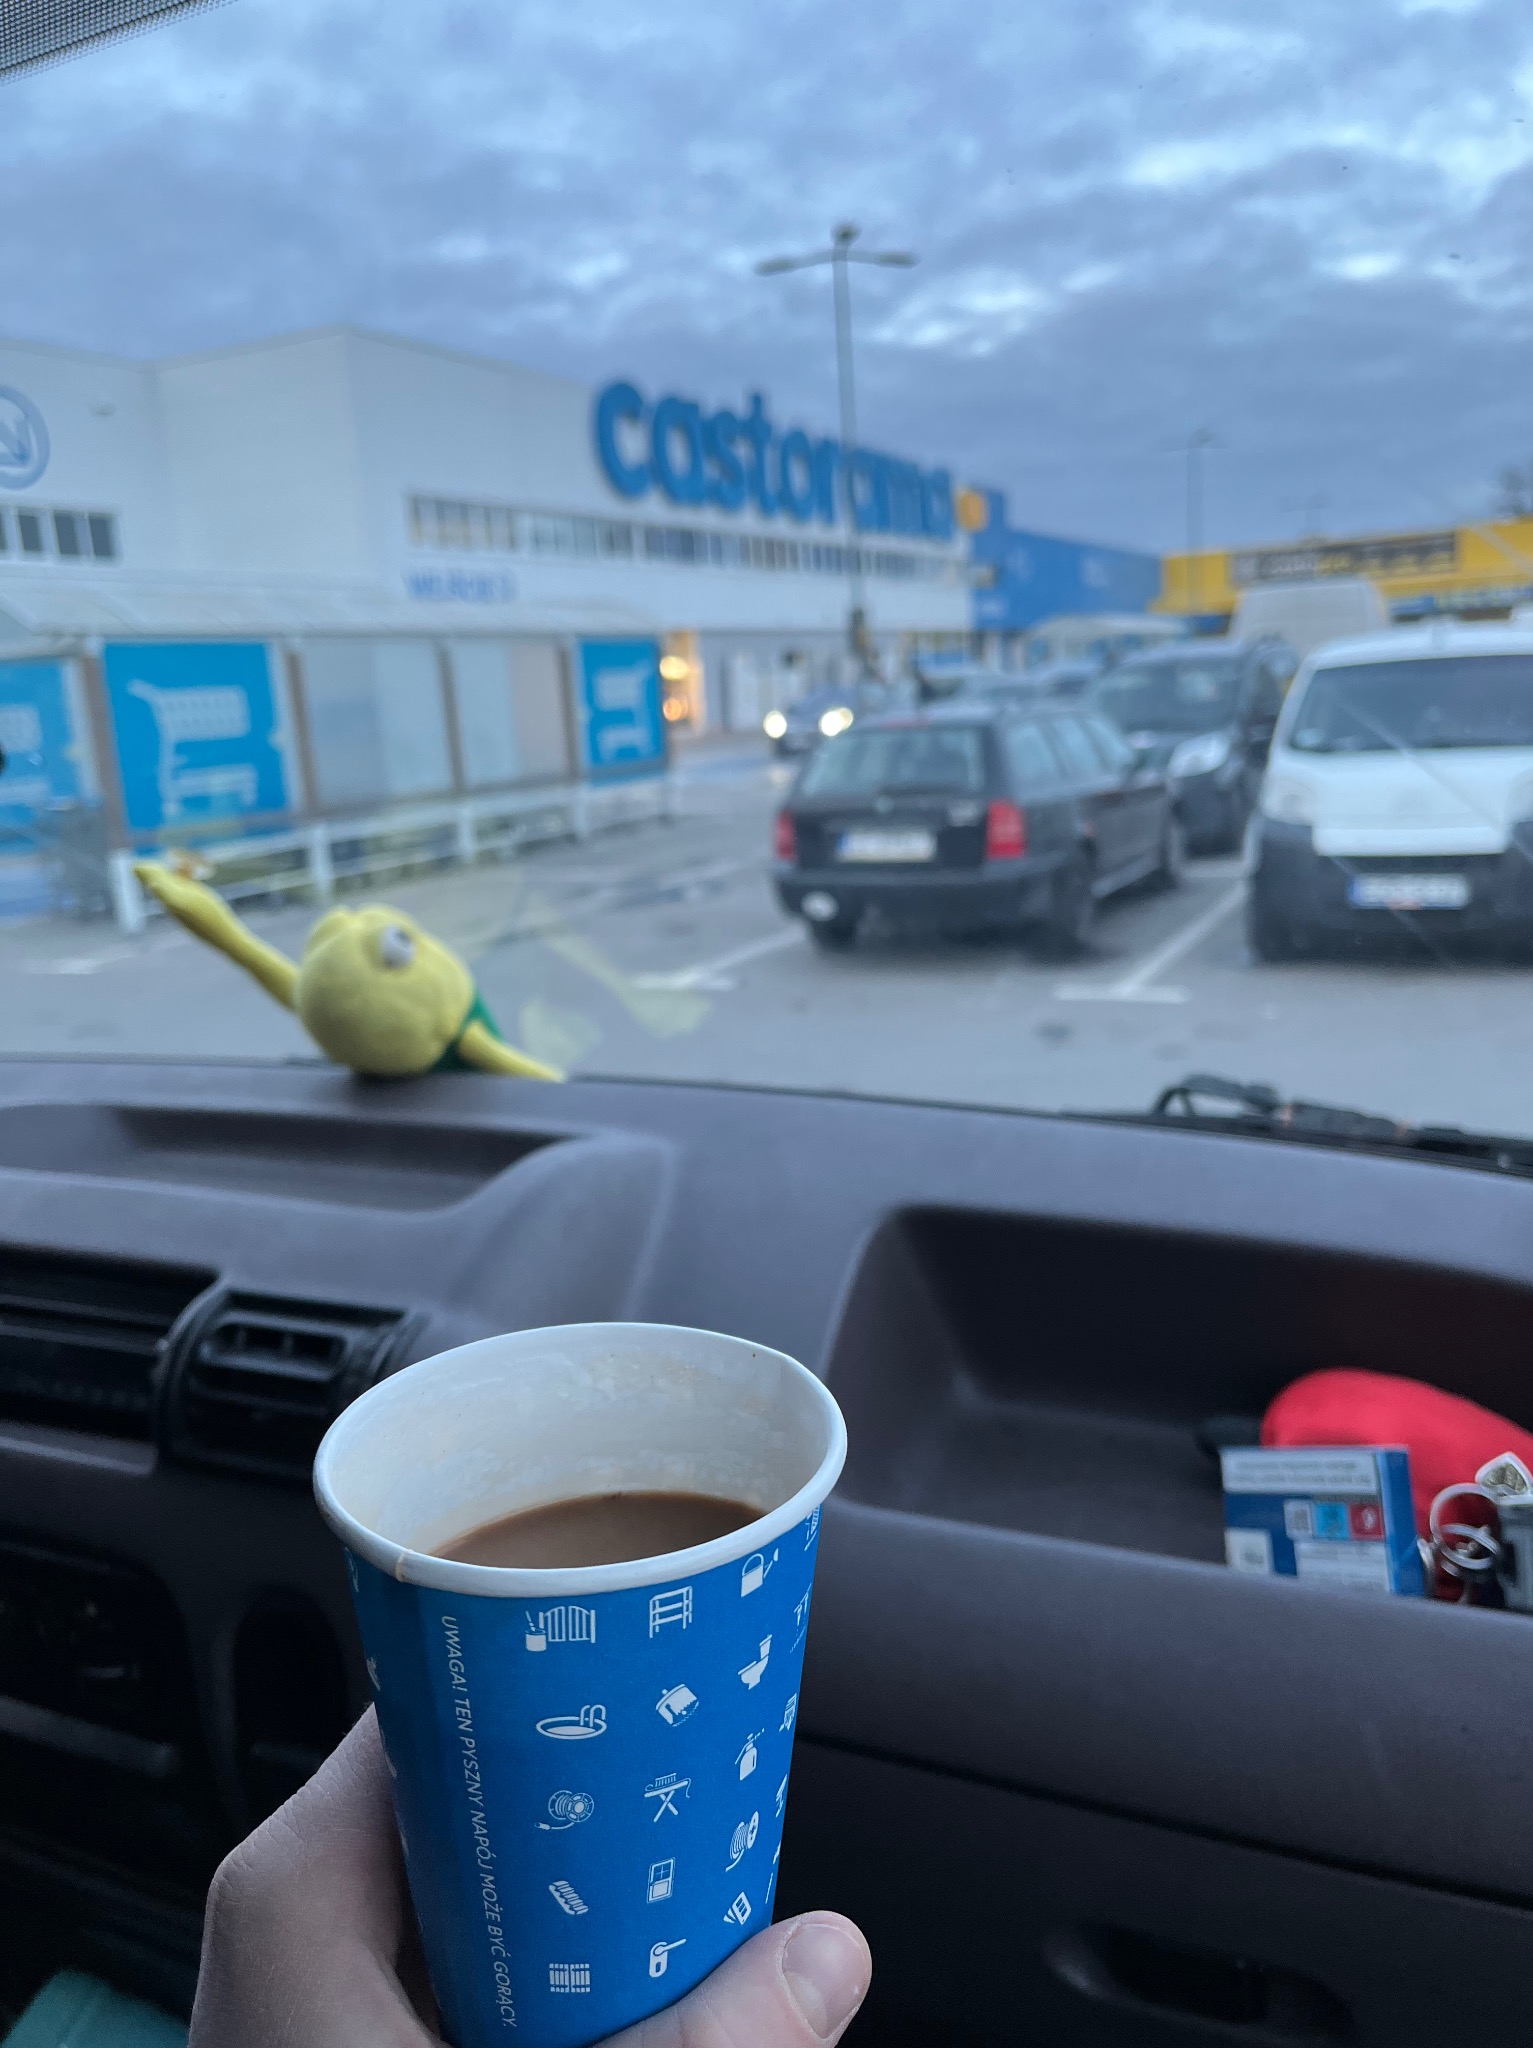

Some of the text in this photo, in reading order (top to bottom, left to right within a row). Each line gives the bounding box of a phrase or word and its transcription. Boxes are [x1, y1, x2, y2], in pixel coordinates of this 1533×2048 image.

[441, 1615, 468, 1693] UWAGA!
[453, 1698, 474, 1733] TEN
[460, 1736, 484, 1807] PYSZNY
[470, 1809, 497, 1870] NAPÓJ
[479, 1873, 504, 1923] MOŻE
[487, 1924, 512, 1958] BYĆ
